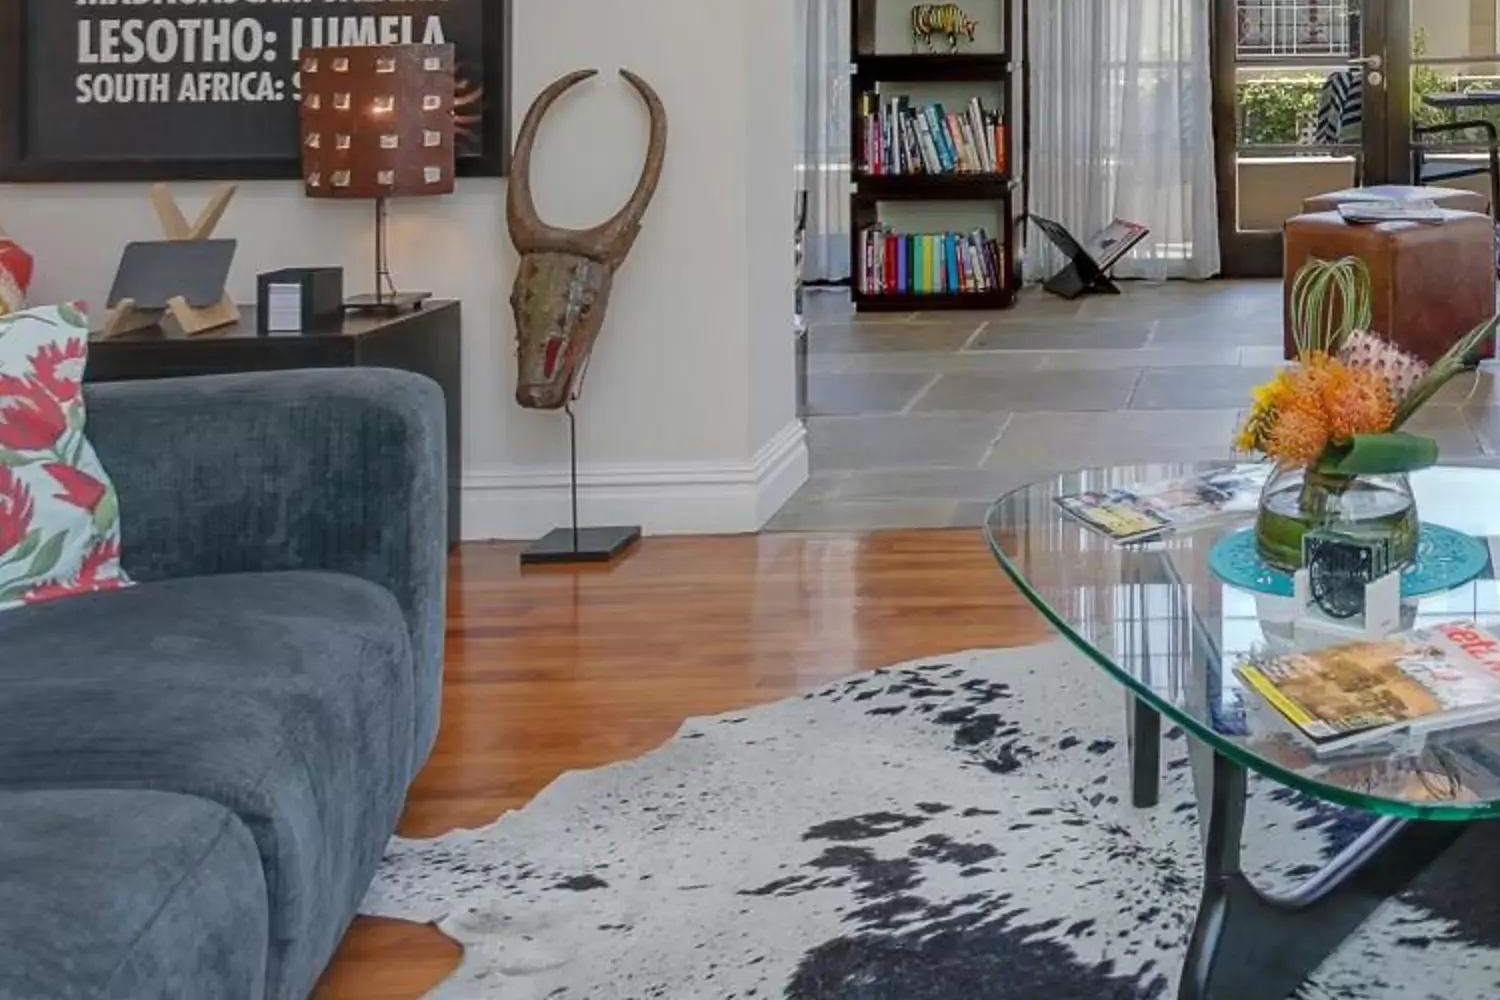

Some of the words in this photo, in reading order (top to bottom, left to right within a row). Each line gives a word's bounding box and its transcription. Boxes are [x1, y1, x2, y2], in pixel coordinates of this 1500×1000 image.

[77, 17, 277, 64] LESOTHO:
[75, 72, 170, 104] SOUTH
[176, 71, 285, 102] AFRICA:
